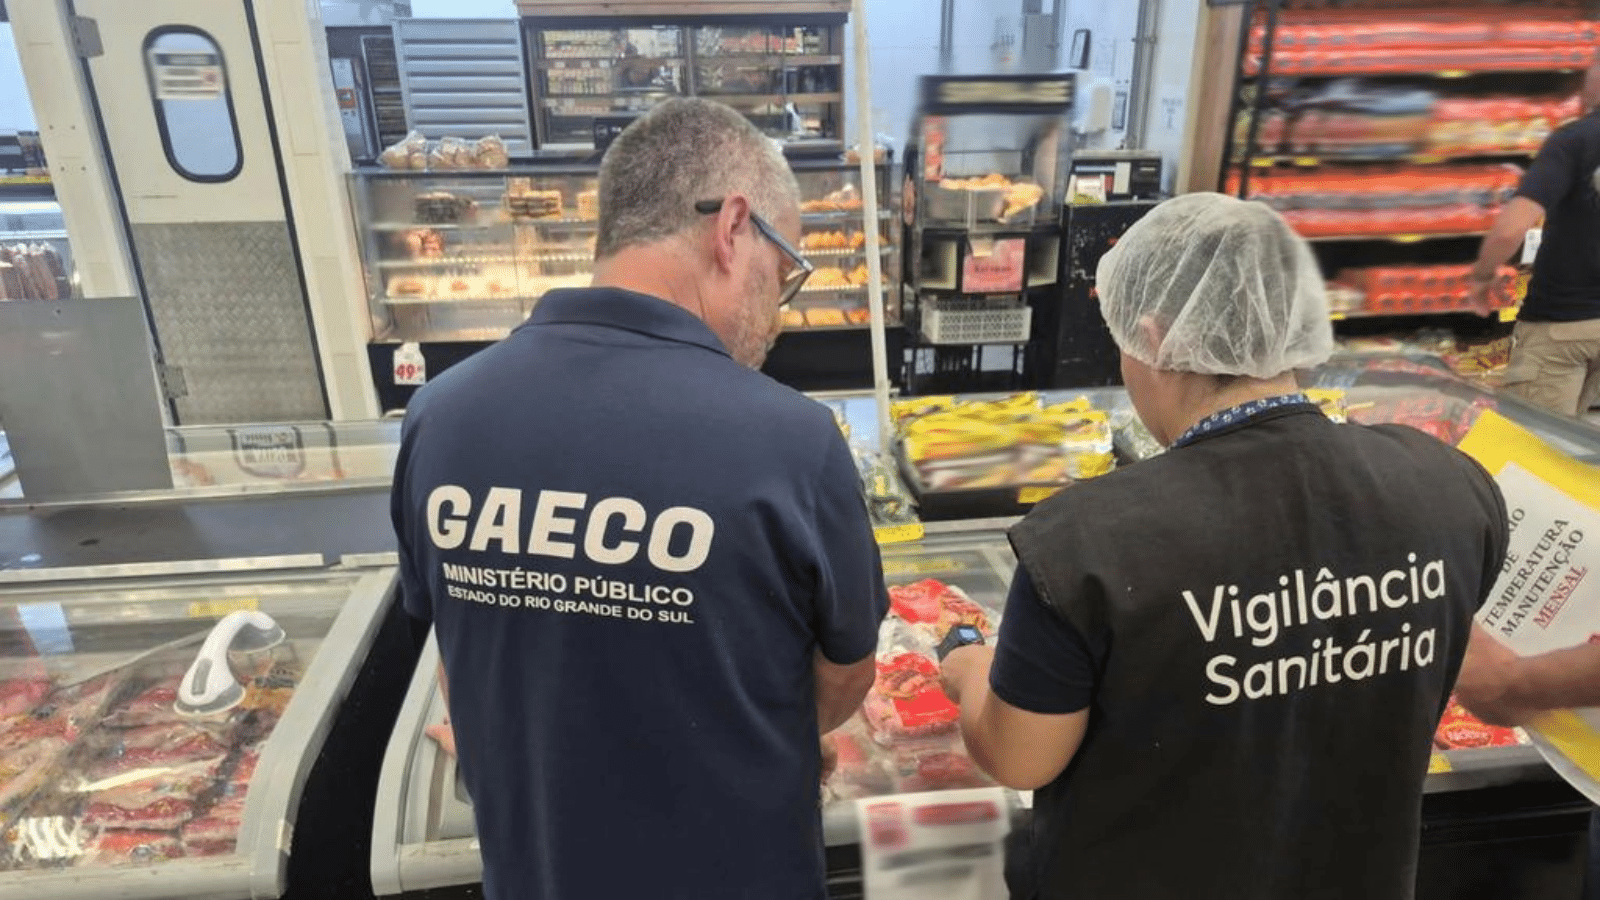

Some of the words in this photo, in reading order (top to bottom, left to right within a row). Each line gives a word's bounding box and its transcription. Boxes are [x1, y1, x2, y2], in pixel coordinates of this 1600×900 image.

[426, 484, 715, 572] GAECO
[1507, 508, 1526, 532] IO
[442, 562, 567, 593] MINISTÉRIO
[574, 576, 694, 606] PÚBLICO
[1483, 519, 1570, 627] TEMPERATURA
[1501, 530, 1583, 637] MANUTENÇÃO
[1502, 551, 1519, 574] DE
[1533, 566, 1587, 628] MENSAL
[448, 585, 496, 605] ESTADO
[499, 593, 520, 607] DO
[525, 595, 551, 609] RIO
[554, 599, 622, 618] GRANDE
[627, 607, 653, 621] DO
[658, 609, 695, 624] SUL
[1182, 552, 1446, 647] Vigilância
[1205, 622, 1436, 706] Sanitária
